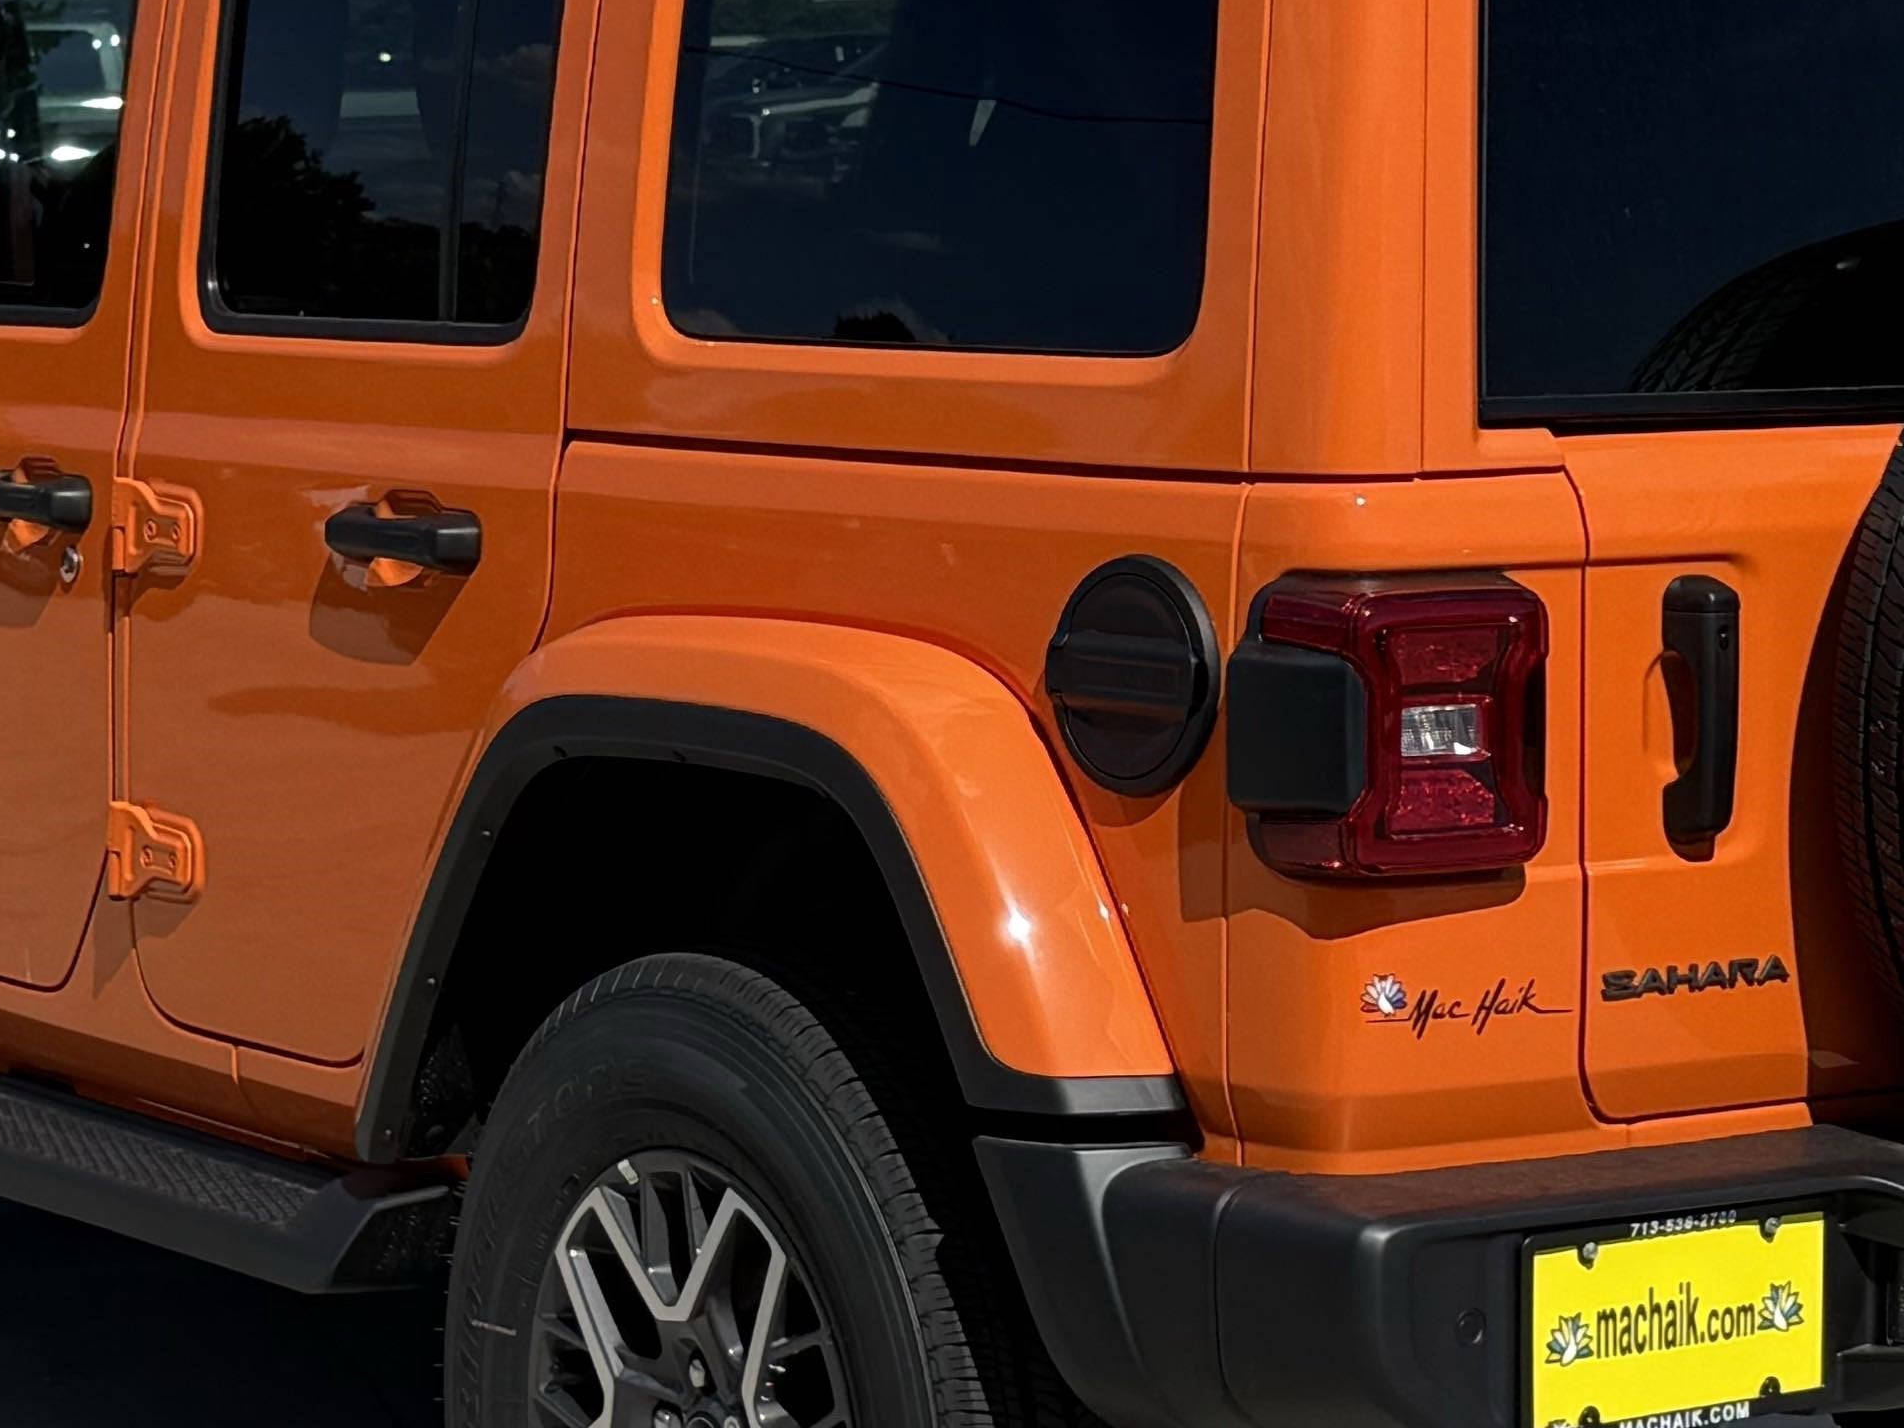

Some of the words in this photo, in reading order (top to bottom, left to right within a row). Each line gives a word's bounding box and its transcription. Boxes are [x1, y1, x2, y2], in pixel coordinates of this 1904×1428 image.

[1408, 989, 1470, 1040] Mac
[1470, 977, 1558, 1036] Haik
[1601, 955, 1790, 1002] SAHARA
[1596, 1280, 1756, 1360] machaik.com
